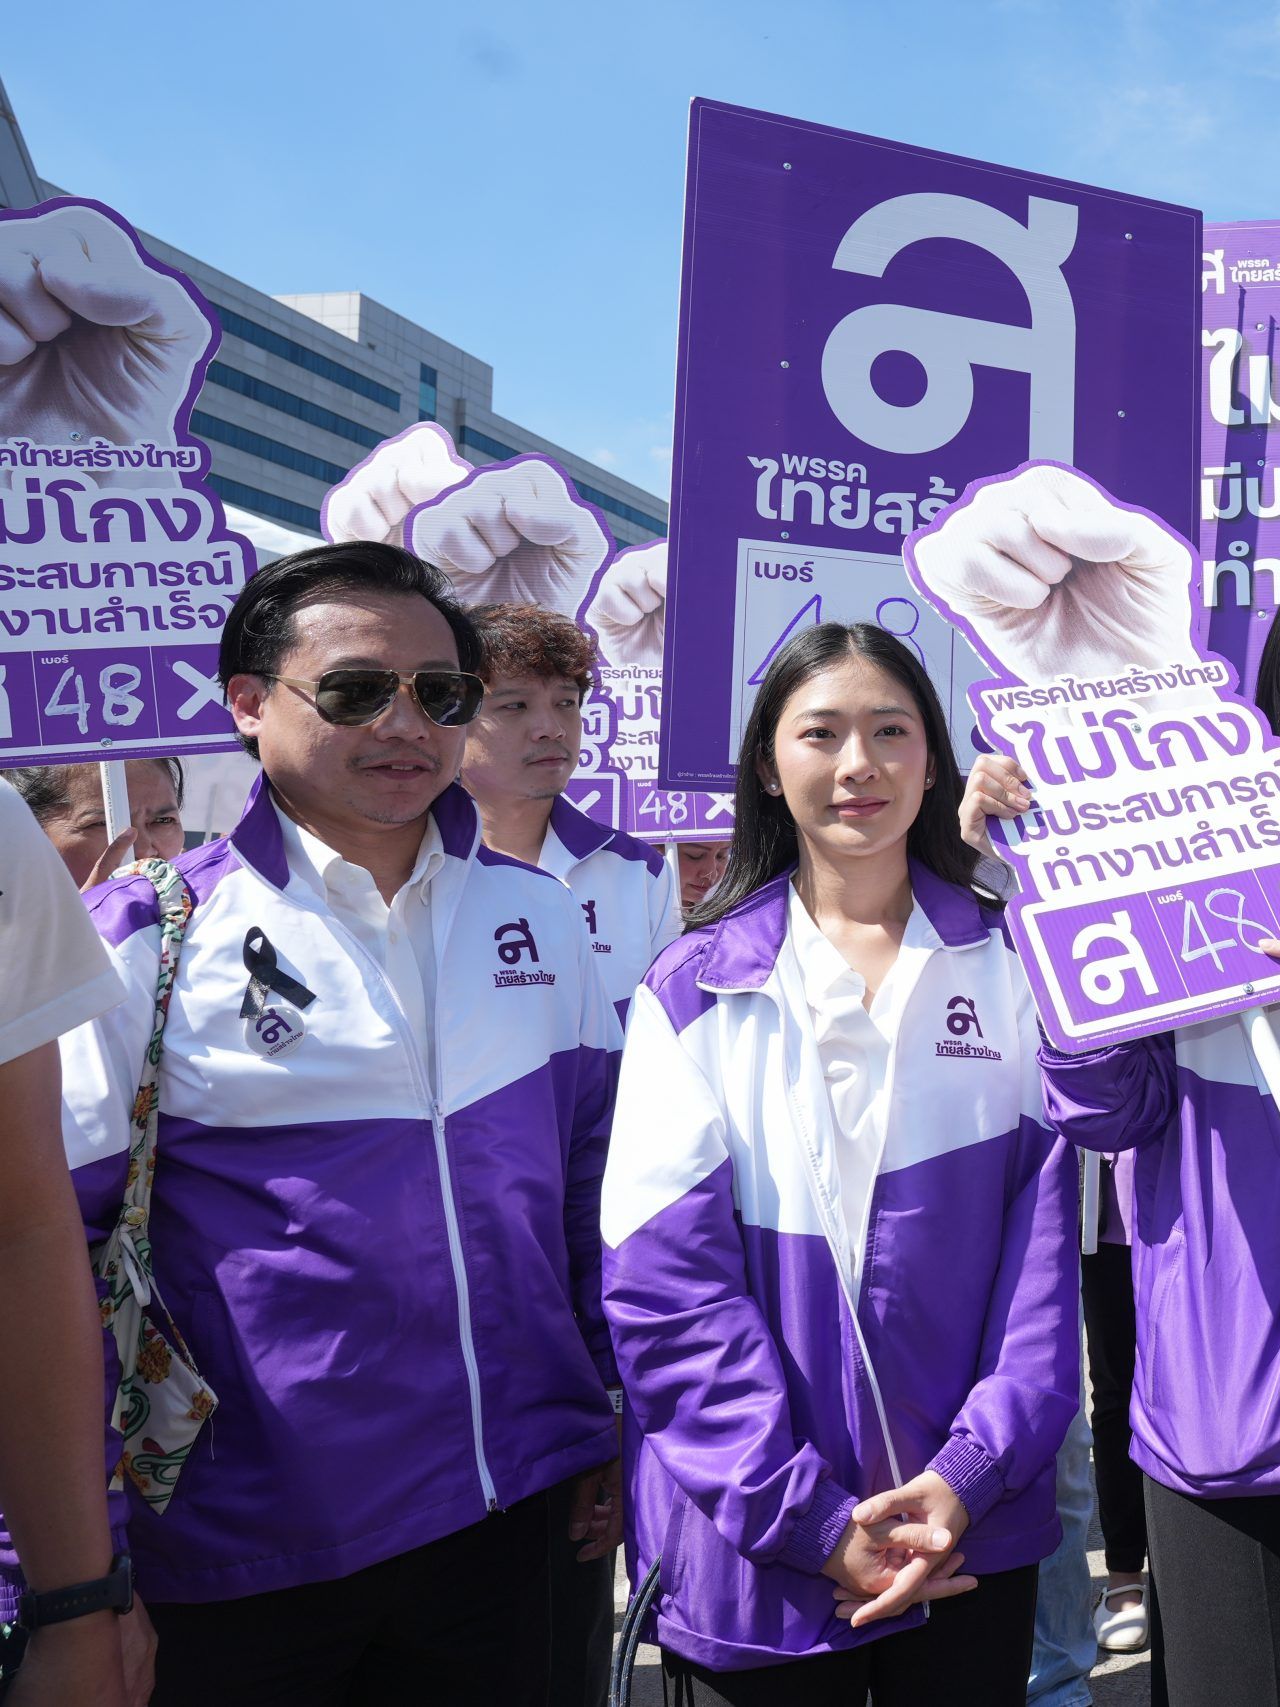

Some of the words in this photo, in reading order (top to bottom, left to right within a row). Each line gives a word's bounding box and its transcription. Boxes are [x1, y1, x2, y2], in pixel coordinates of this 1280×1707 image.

[1237, 259, 1270, 268] พรรค
[781, 453, 868, 484] พรรค
[754, 561, 815, 583] เบอร์
[41, 655, 69, 665] เบอร์
[44, 663, 145, 734] 48
[987, 664, 1225, 712] พรรคไทยสร้างไทย
[1006, 709, 1251, 786] ไม่โกง
[639, 790, 688, 825] 48
[1157, 890, 1184, 904] เบอร์
[1181, 888, 1278, 973] 48
[493, 970, 556, 985] ไทยสร้างไทย
[936, 1043, 1001, 1059] ไทยสร้างไทย
